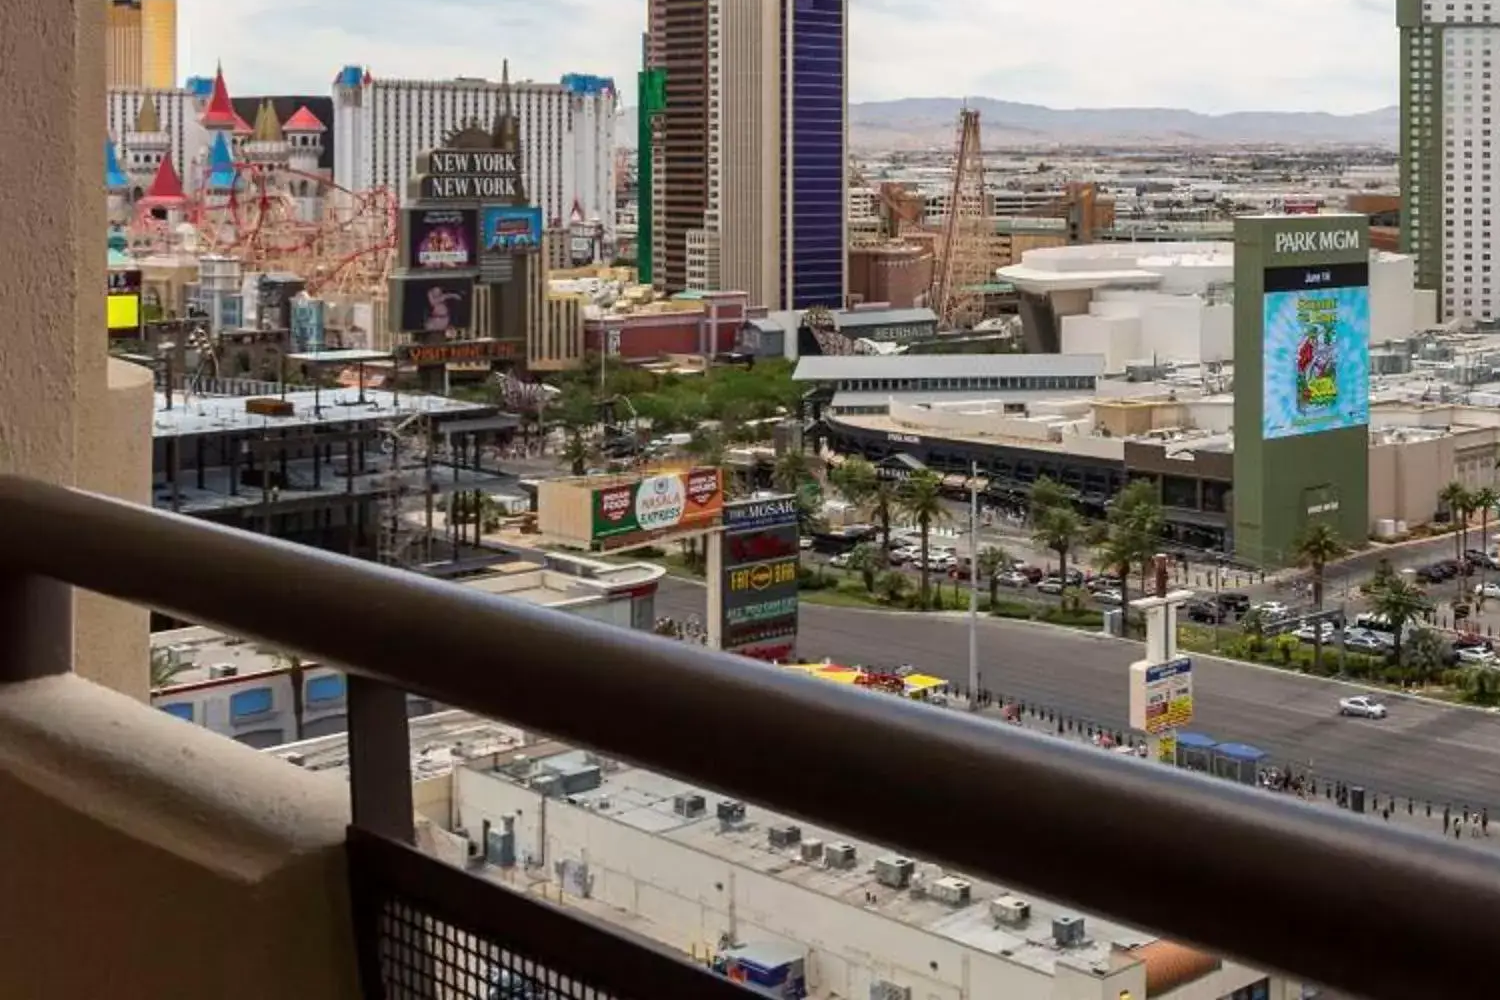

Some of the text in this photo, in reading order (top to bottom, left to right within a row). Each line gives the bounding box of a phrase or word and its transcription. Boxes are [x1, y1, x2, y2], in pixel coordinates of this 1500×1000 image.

[432, 152, 516, 173] NEW YORK
[432, 176, 516, 197] NEW YORK
[1275, 229, 1360, 253] PARK MGM
